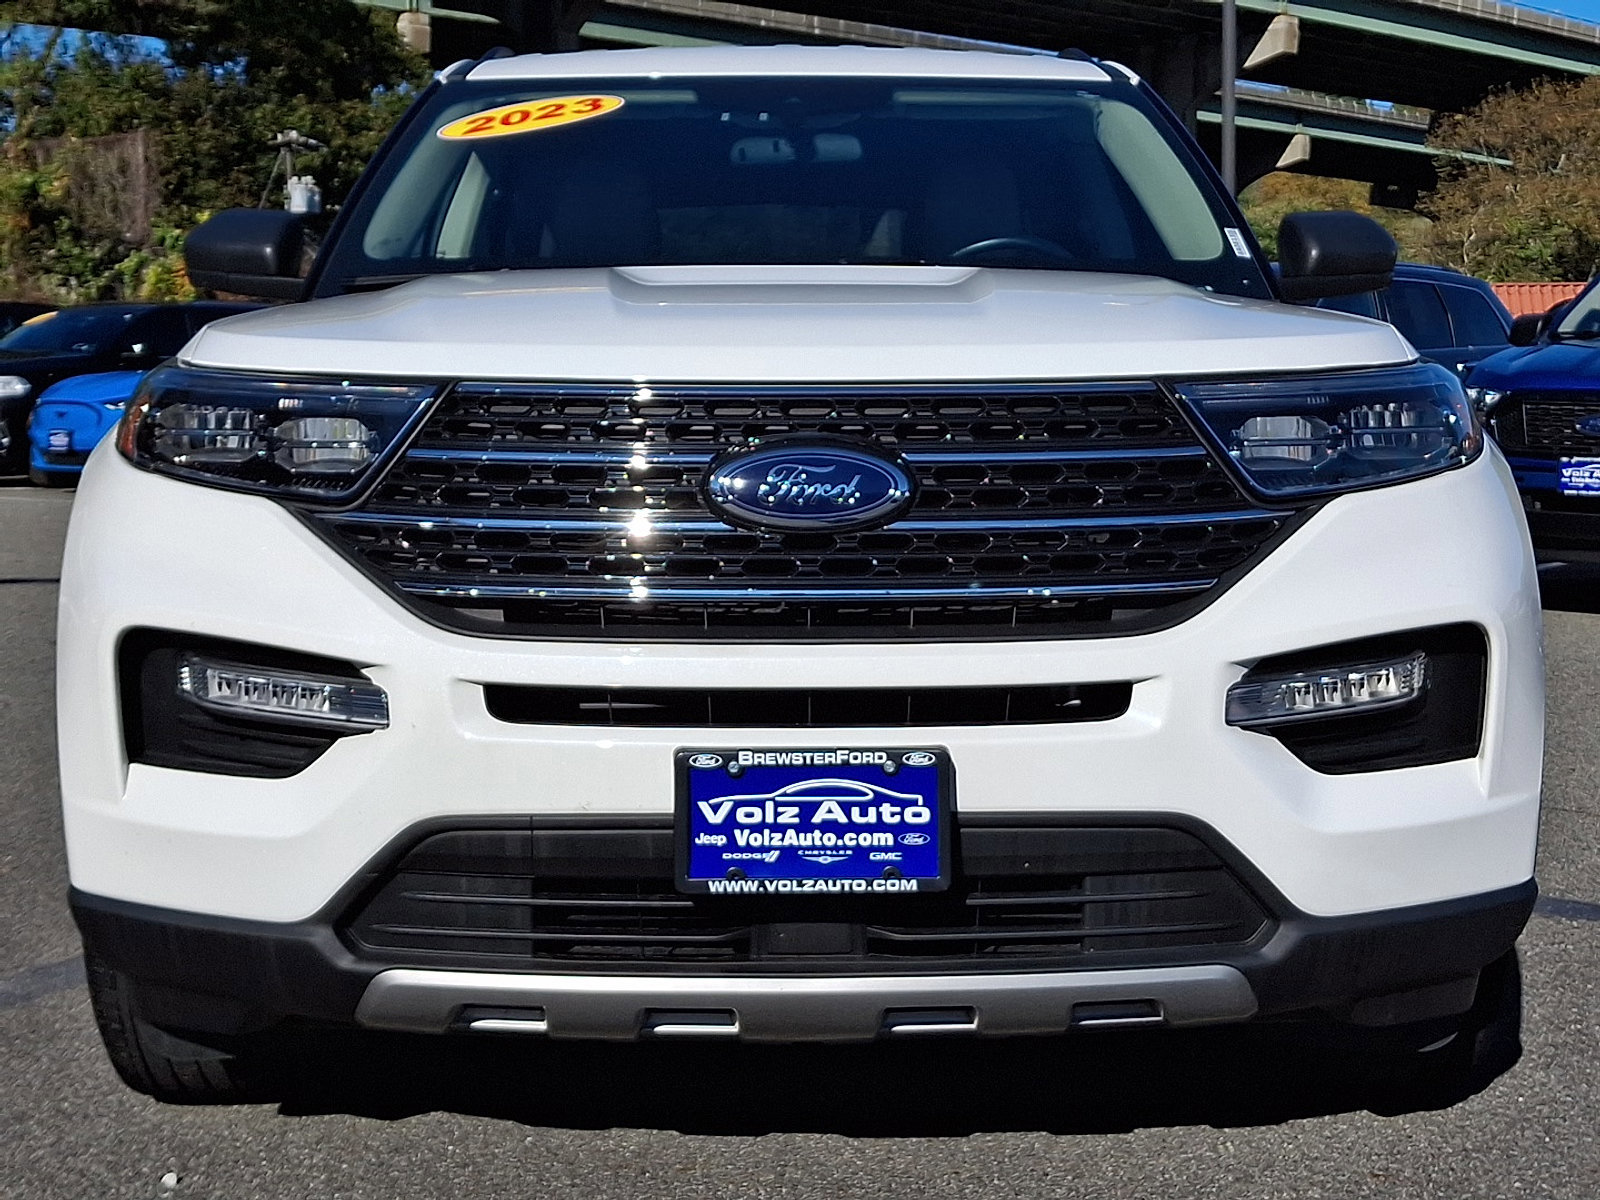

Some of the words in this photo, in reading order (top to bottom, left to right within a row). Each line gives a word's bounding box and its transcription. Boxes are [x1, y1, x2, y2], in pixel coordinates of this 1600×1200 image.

[462, 98, 604, 136] 2023
[697, 800, 800, 824] Volz
[810, 800, 931, 824] Auto
[695, 833, 727, 846] Jeep
[734, 829, 894, 846] VolzAuto.com
[869, 852, 903, 860] GMC
[708, 880, 918, 893] WWW.VOLZAUTO.COM
